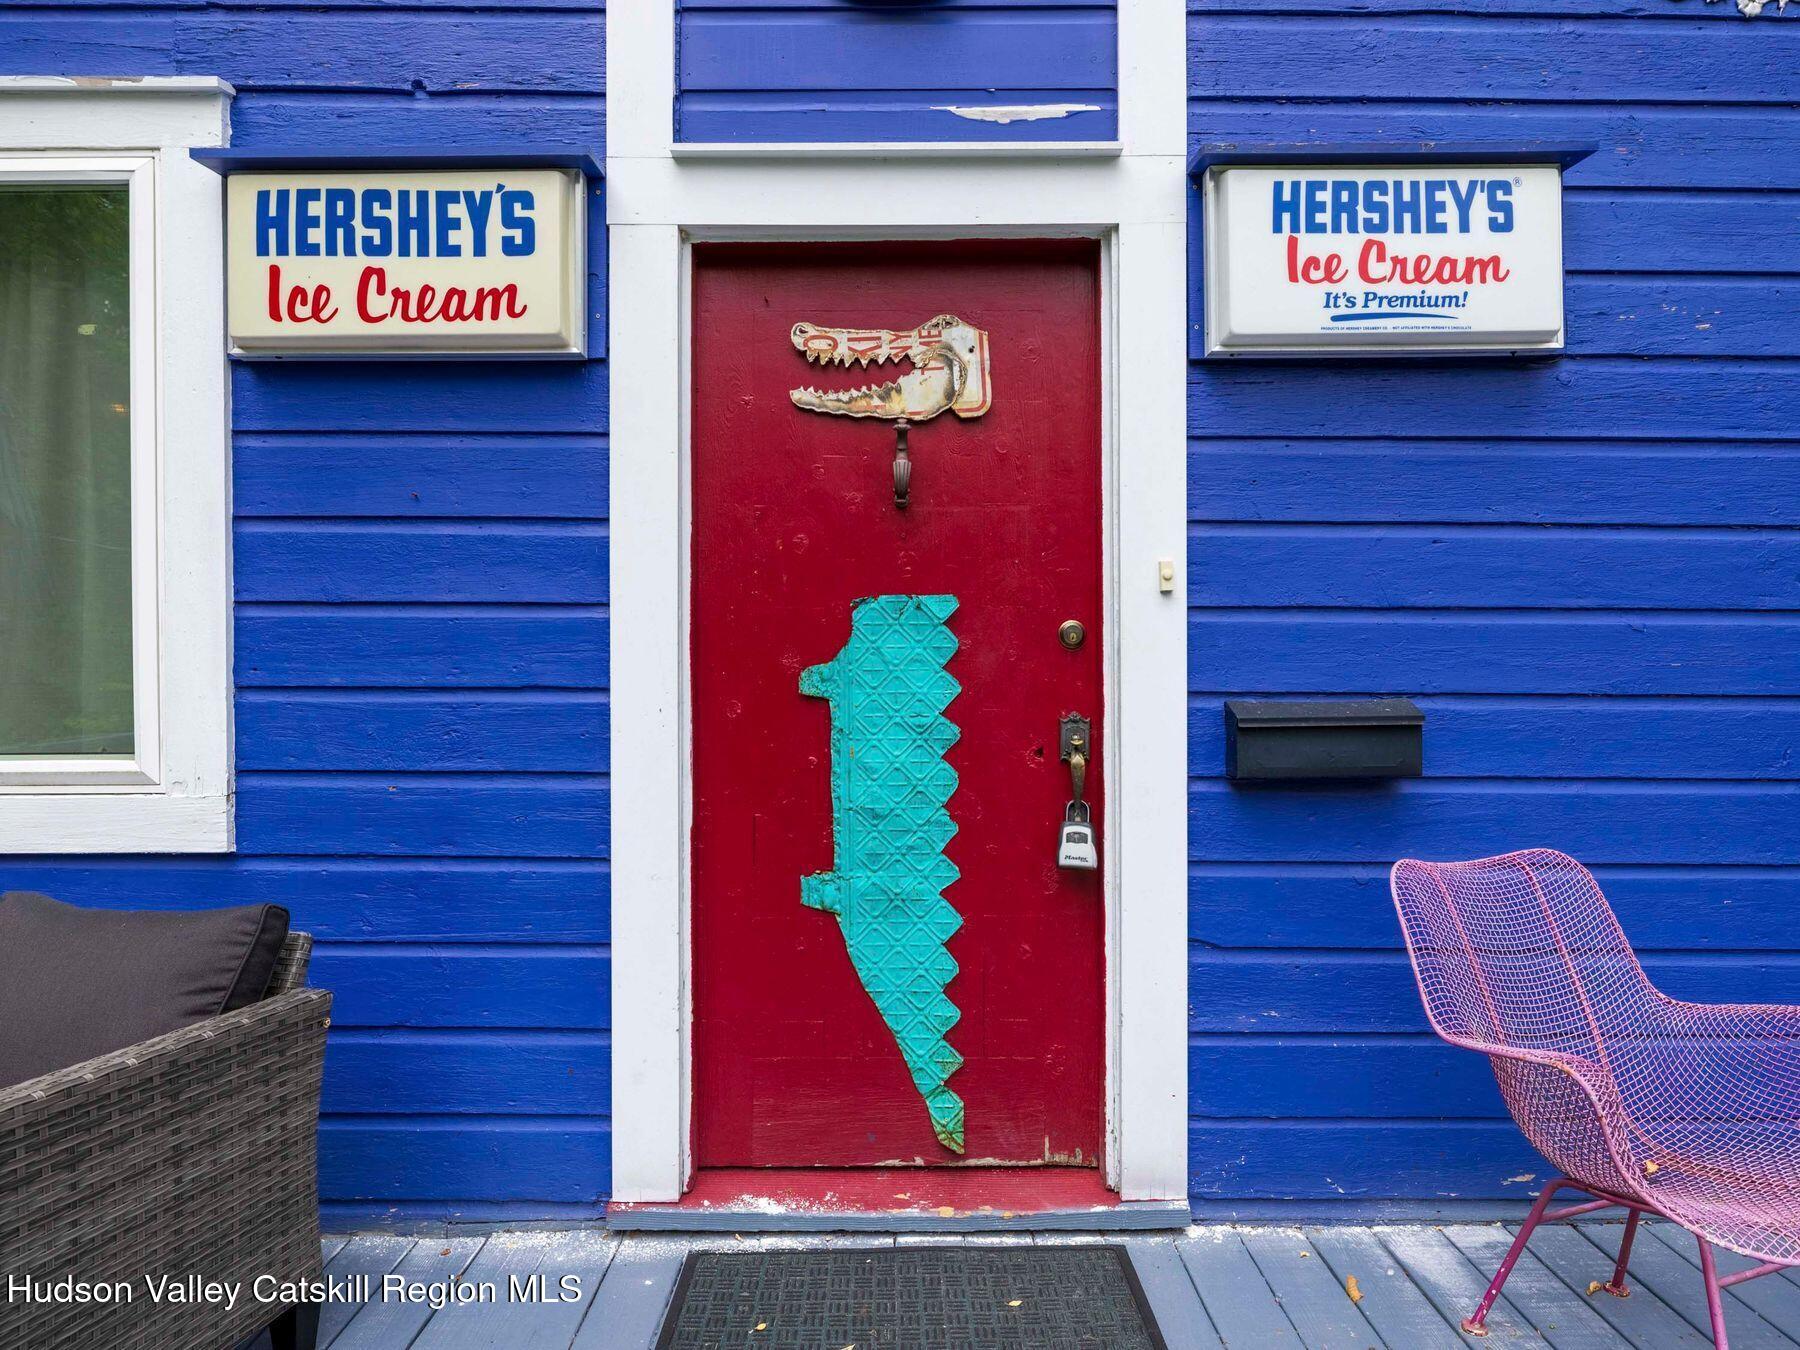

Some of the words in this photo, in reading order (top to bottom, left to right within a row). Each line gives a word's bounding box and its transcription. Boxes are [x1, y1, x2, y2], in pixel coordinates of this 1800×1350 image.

[256, 183, 536, 258] HERSHEY'S
[1287, 235, 1348, 285] Ice
[1358, 238, 1510, 285] Cream
[268, 264, 339, 323] Ice
[356, 265, 528, 324] Cream
[1323, 291, 1357, 309] It's
[1363, 289, 1469, 309] Premium!
